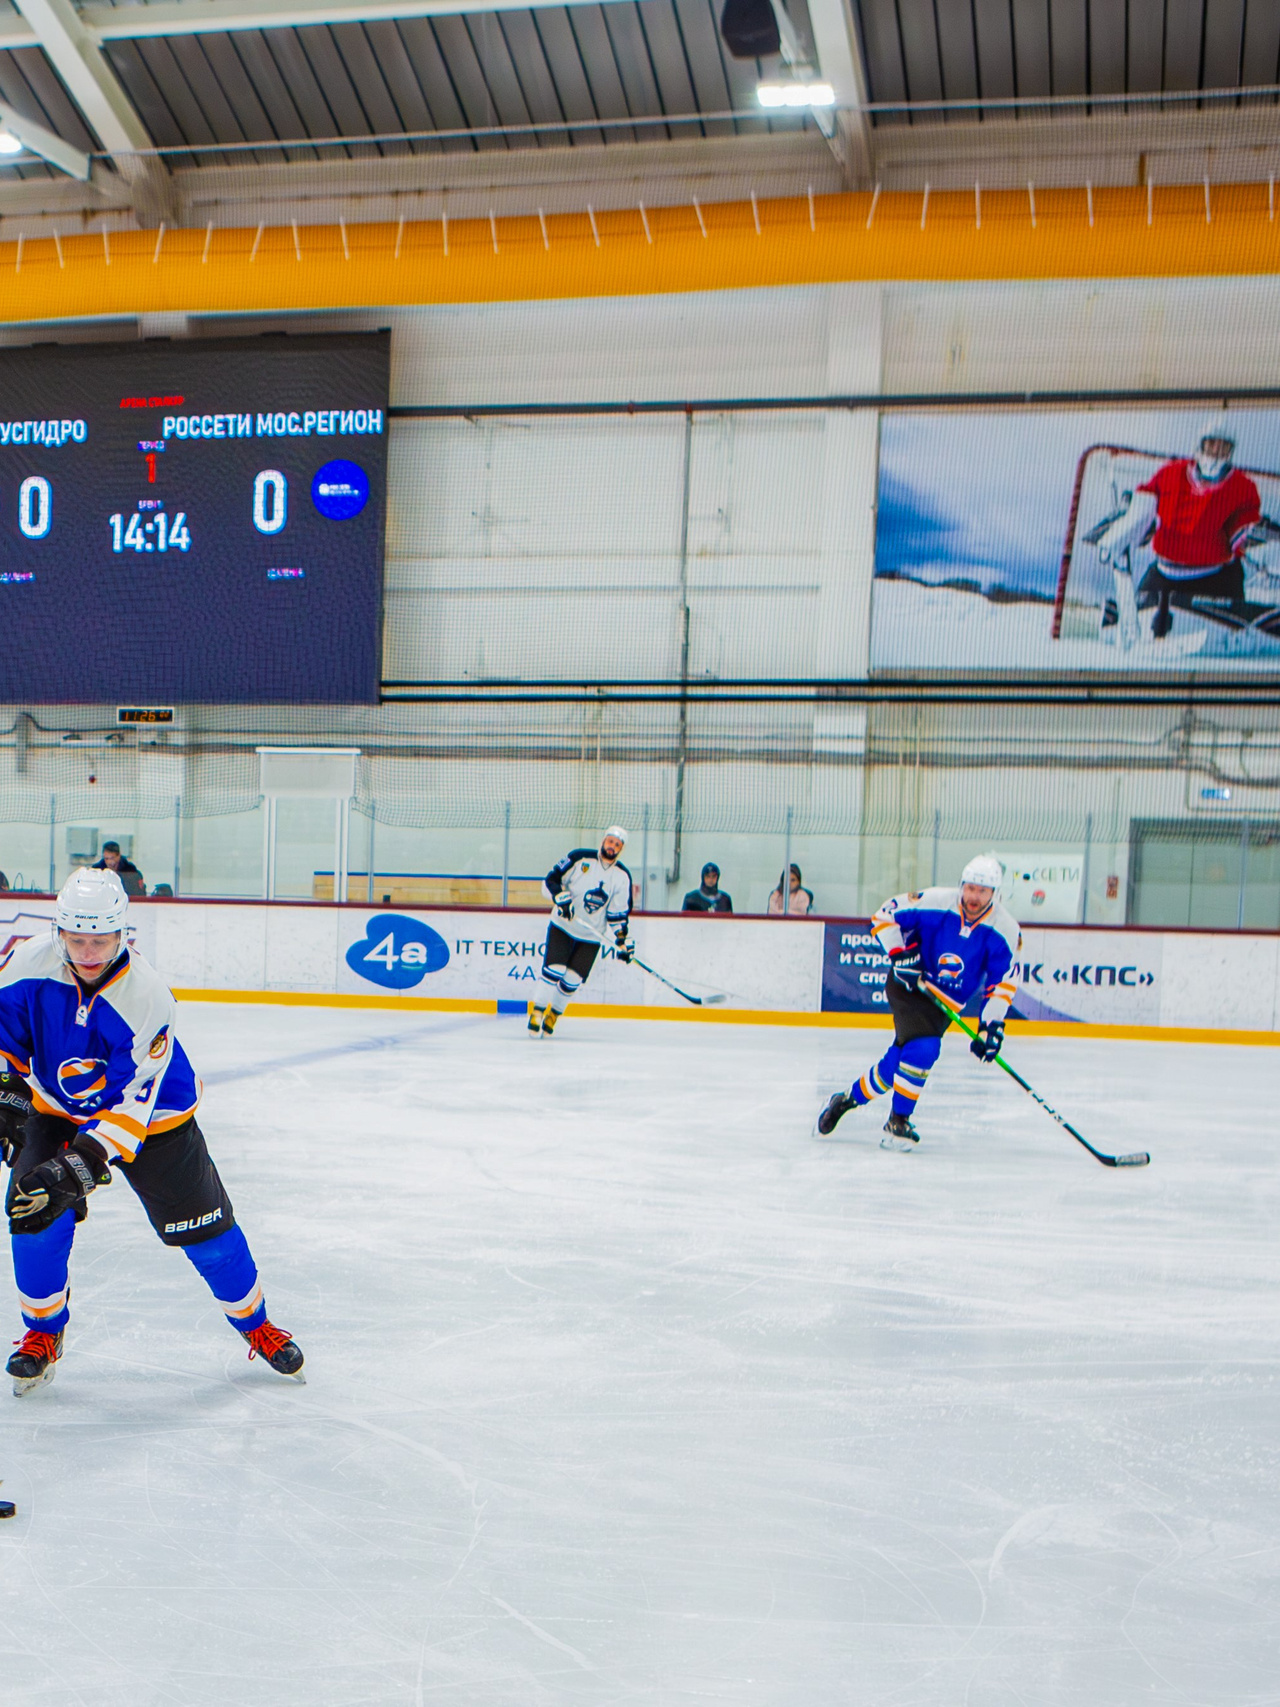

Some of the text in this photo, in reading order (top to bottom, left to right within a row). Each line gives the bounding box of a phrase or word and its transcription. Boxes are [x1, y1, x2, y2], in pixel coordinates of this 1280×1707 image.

[163, 409, 383, 439] РОССЕТИ МОС.РЕГИОН
[145, 453, 156, 483] 1
[19, 475, 52, 540] 0
[252, 468, 288, 535] 0
[108, 512, 192, 553] 14:14
[456, 940, 474, 955] IT
[841, 933, 880, 948] про
[853, 953, 892, 968] стро
[508, 965, 536, 982] 4A
[859, 972, 888, 984] спо
[1053, 964, 1154, 986] «КПС»
